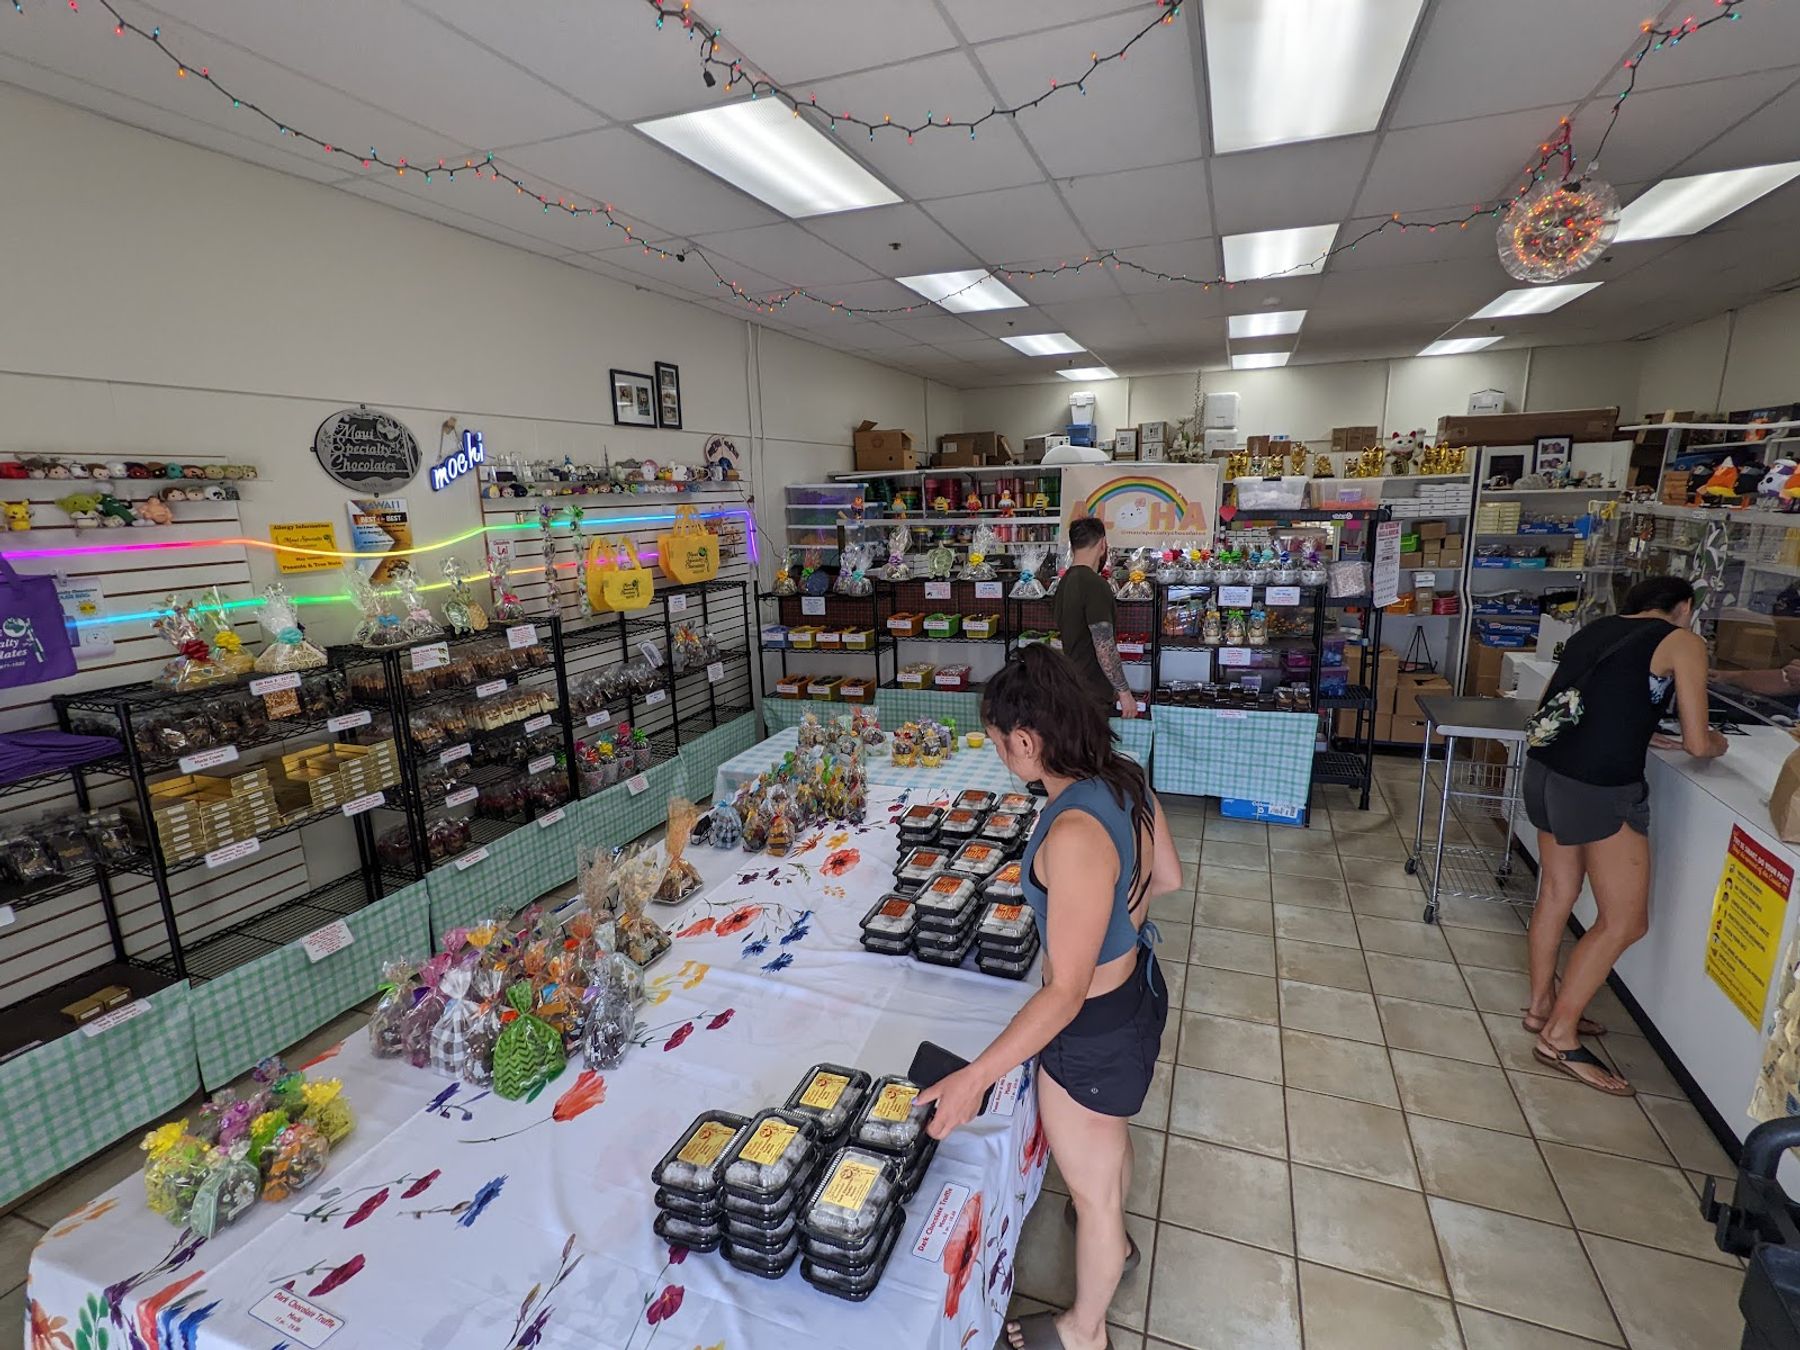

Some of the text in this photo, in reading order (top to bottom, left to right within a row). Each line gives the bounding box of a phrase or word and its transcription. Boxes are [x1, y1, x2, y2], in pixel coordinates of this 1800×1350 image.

[333, 423, 375, 441] Maui
[331, 436, 395, 457] Specialty
[330, 453, 397, 472] Chocolates
[385, 514, 402, 522] BEST
[918, 1188, 953, 1252] Dark Chocolate Truffle
[939, 1214, 949, 1228] Mochi
[274, 1292, 336, 1329] Dark Chocolate Truffle
[287, 1312, 303, 1323] Mochi
